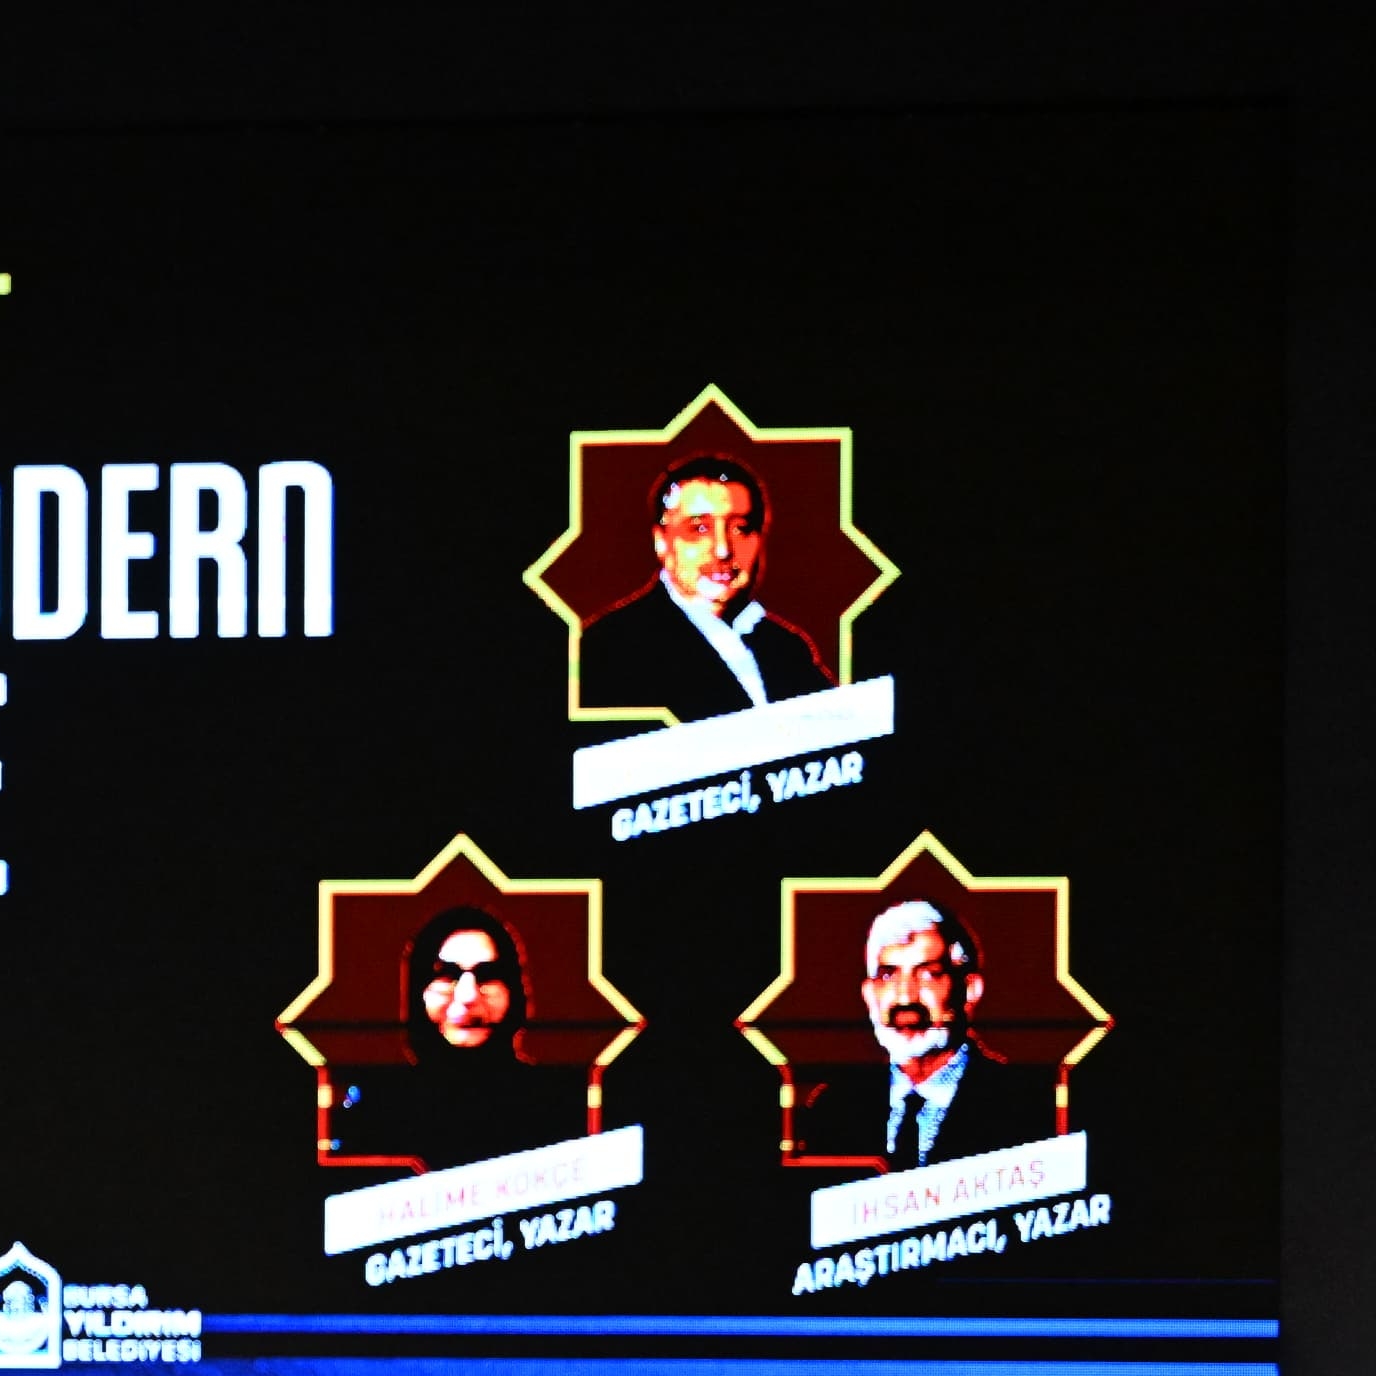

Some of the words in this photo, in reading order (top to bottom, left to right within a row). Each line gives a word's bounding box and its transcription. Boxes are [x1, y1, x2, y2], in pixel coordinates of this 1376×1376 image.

[766, 751, 864, 803] YAZAR
[520, 1200, 616, 1249] YAZAR
[1013, 1193, 1111, 1243] YAZAR
